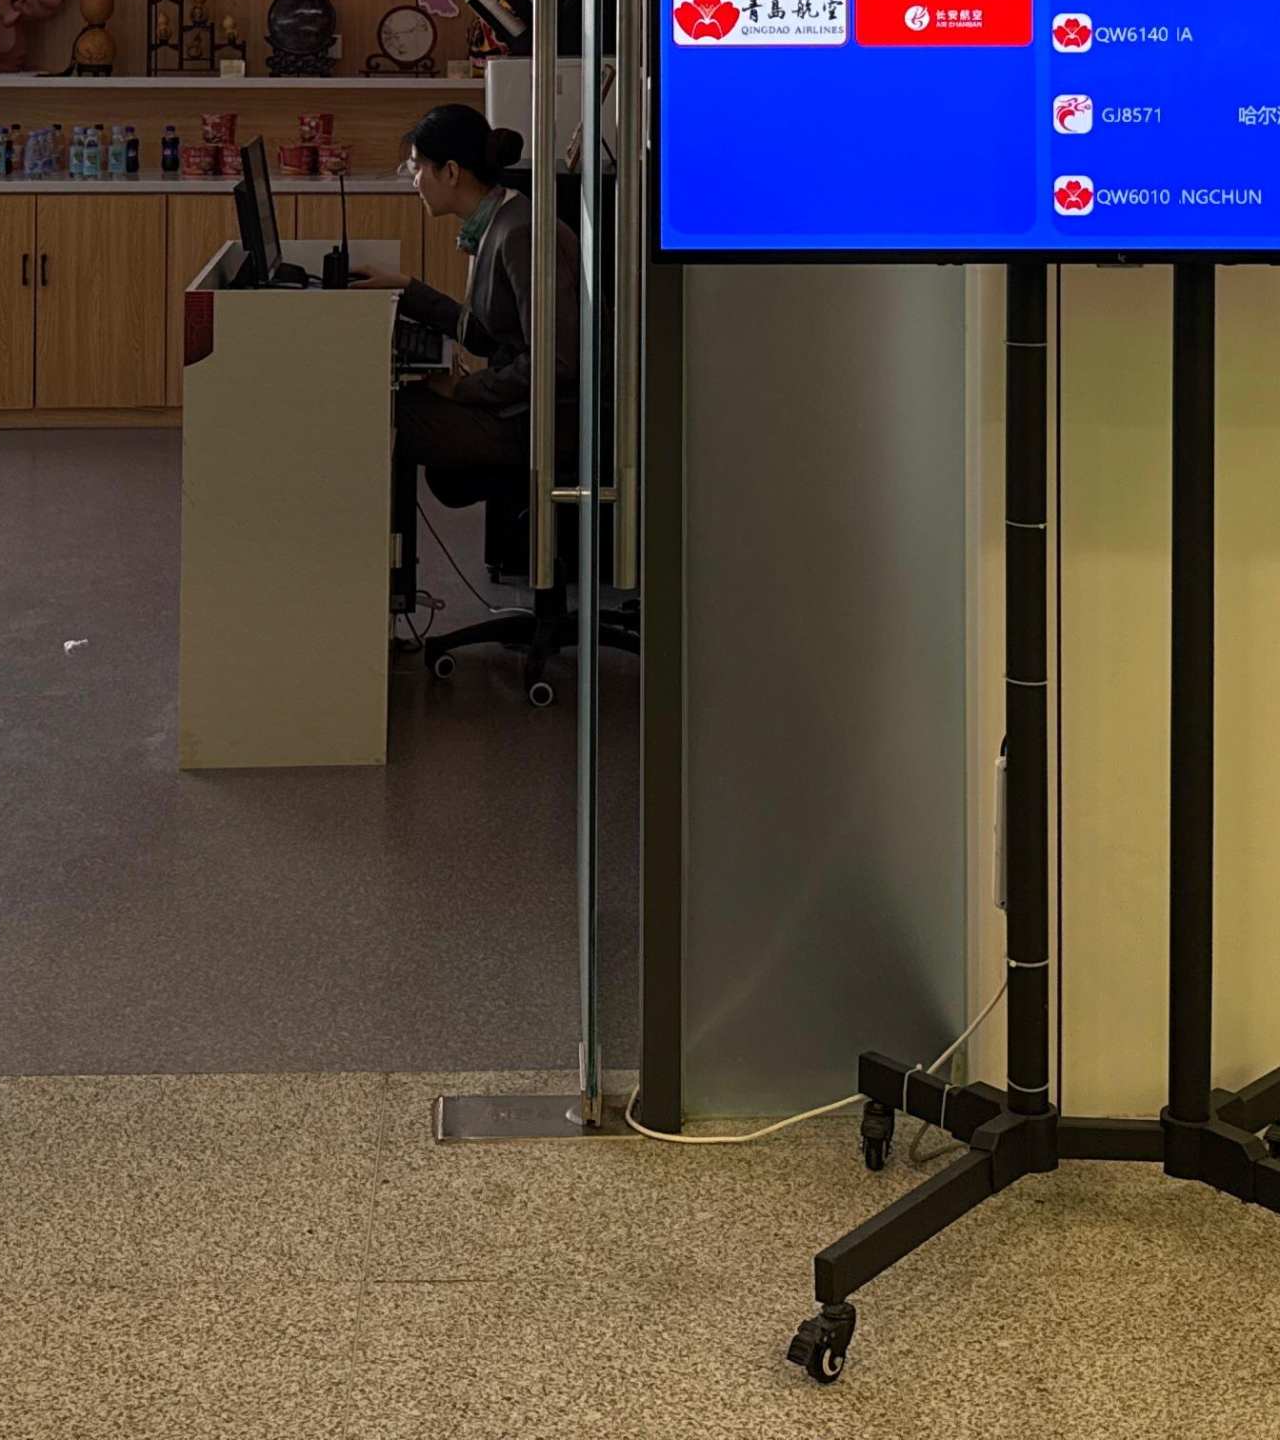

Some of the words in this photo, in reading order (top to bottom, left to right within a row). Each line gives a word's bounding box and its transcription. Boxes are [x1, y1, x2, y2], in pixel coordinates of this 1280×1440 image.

[741, 25, 791, 36] QINGDAO
[794, 25, 845, 35] AIRLINES
[1095, 27, 1169, 44] QW6140
[1101, 107, 1162, 124] GJ8571
[1096, 189, 1171, 206] QW6010
[1178, 189, 1263, 205] NGCHUN
